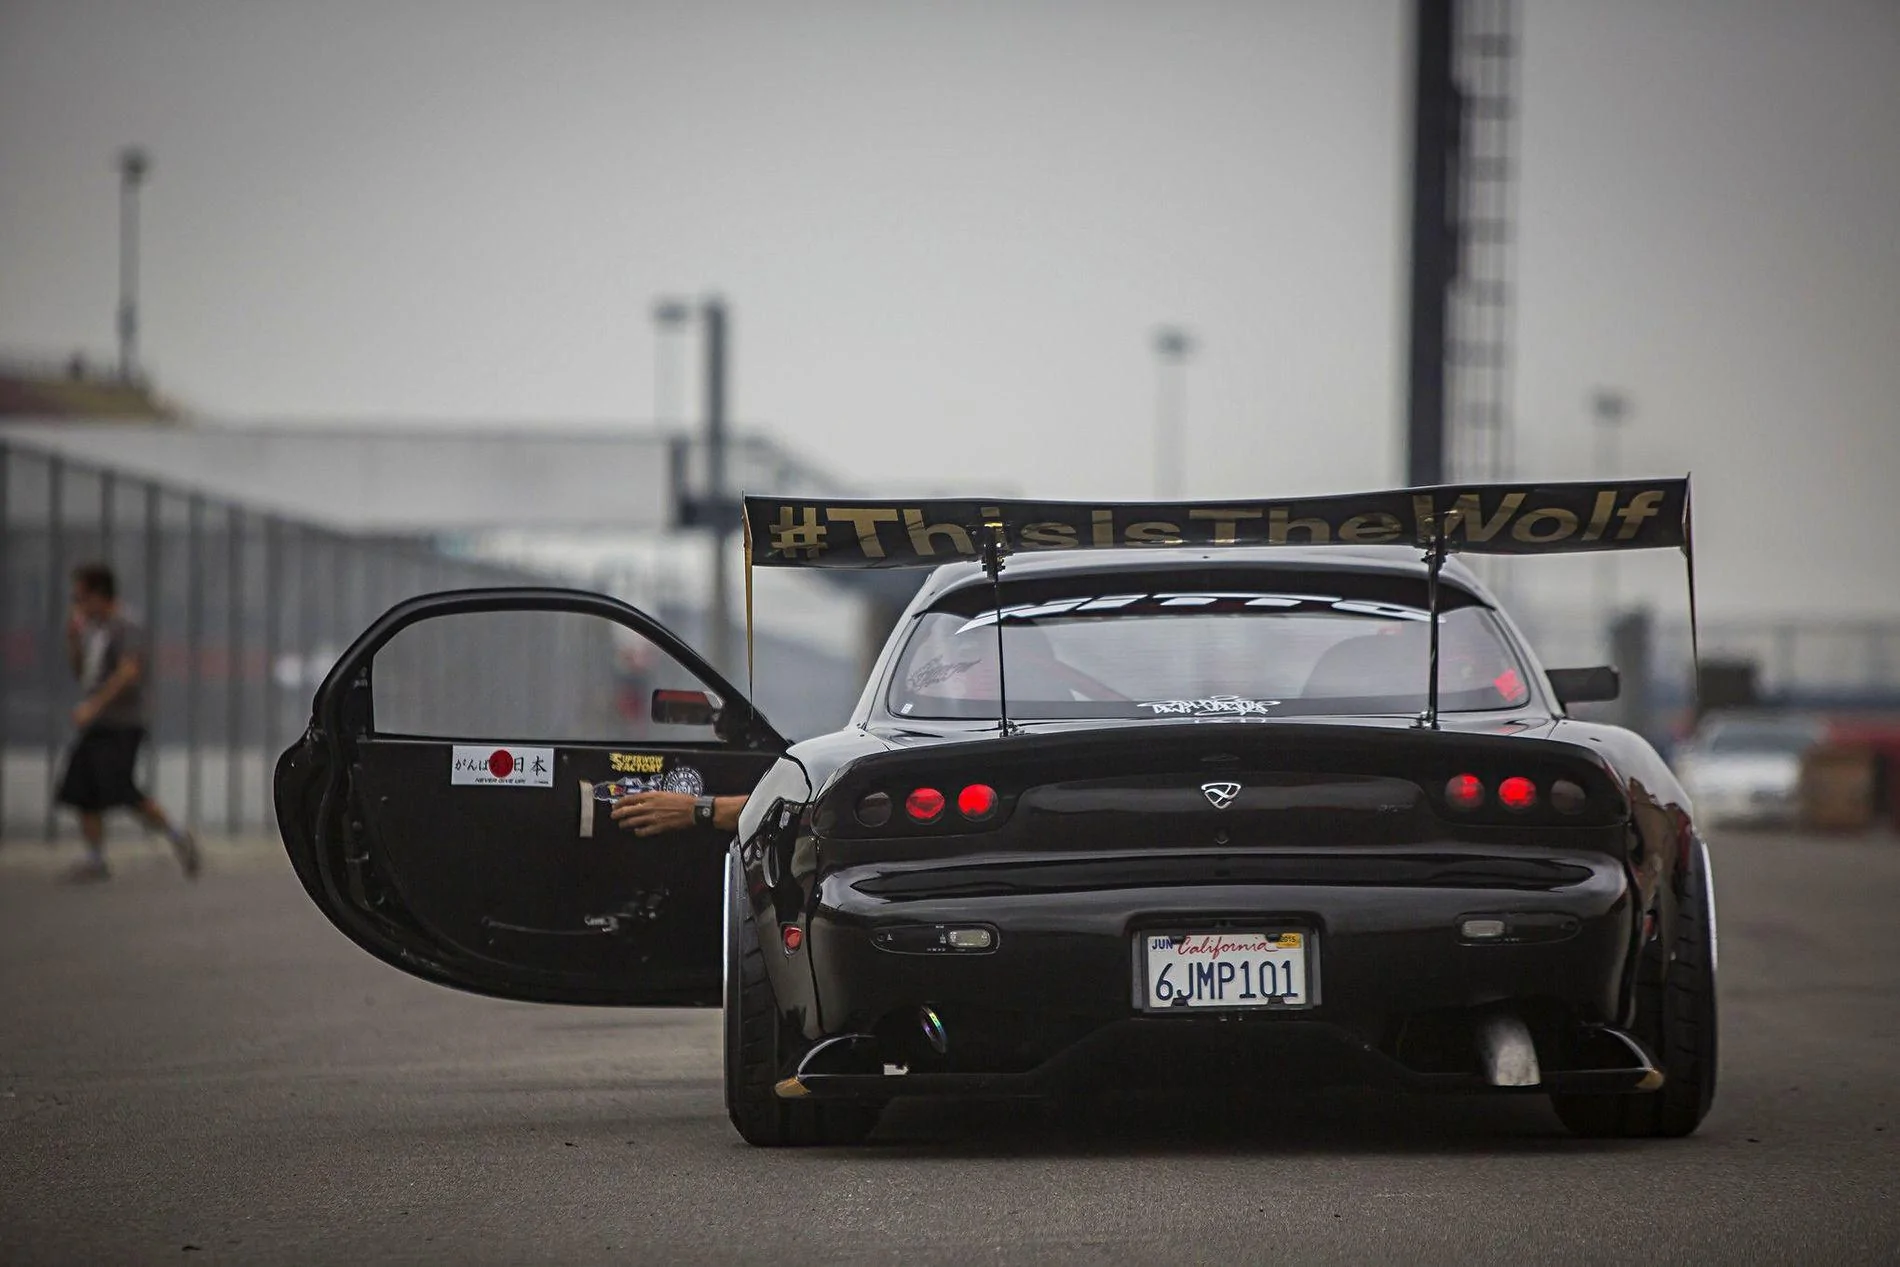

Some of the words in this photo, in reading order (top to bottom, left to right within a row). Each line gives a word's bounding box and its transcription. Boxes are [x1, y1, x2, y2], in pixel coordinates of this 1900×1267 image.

[1152, 938, 1174, 950] JUN
[1178, 936, 1278, 960] California
[1155, 960, 1298, 1001] 6JMP101
